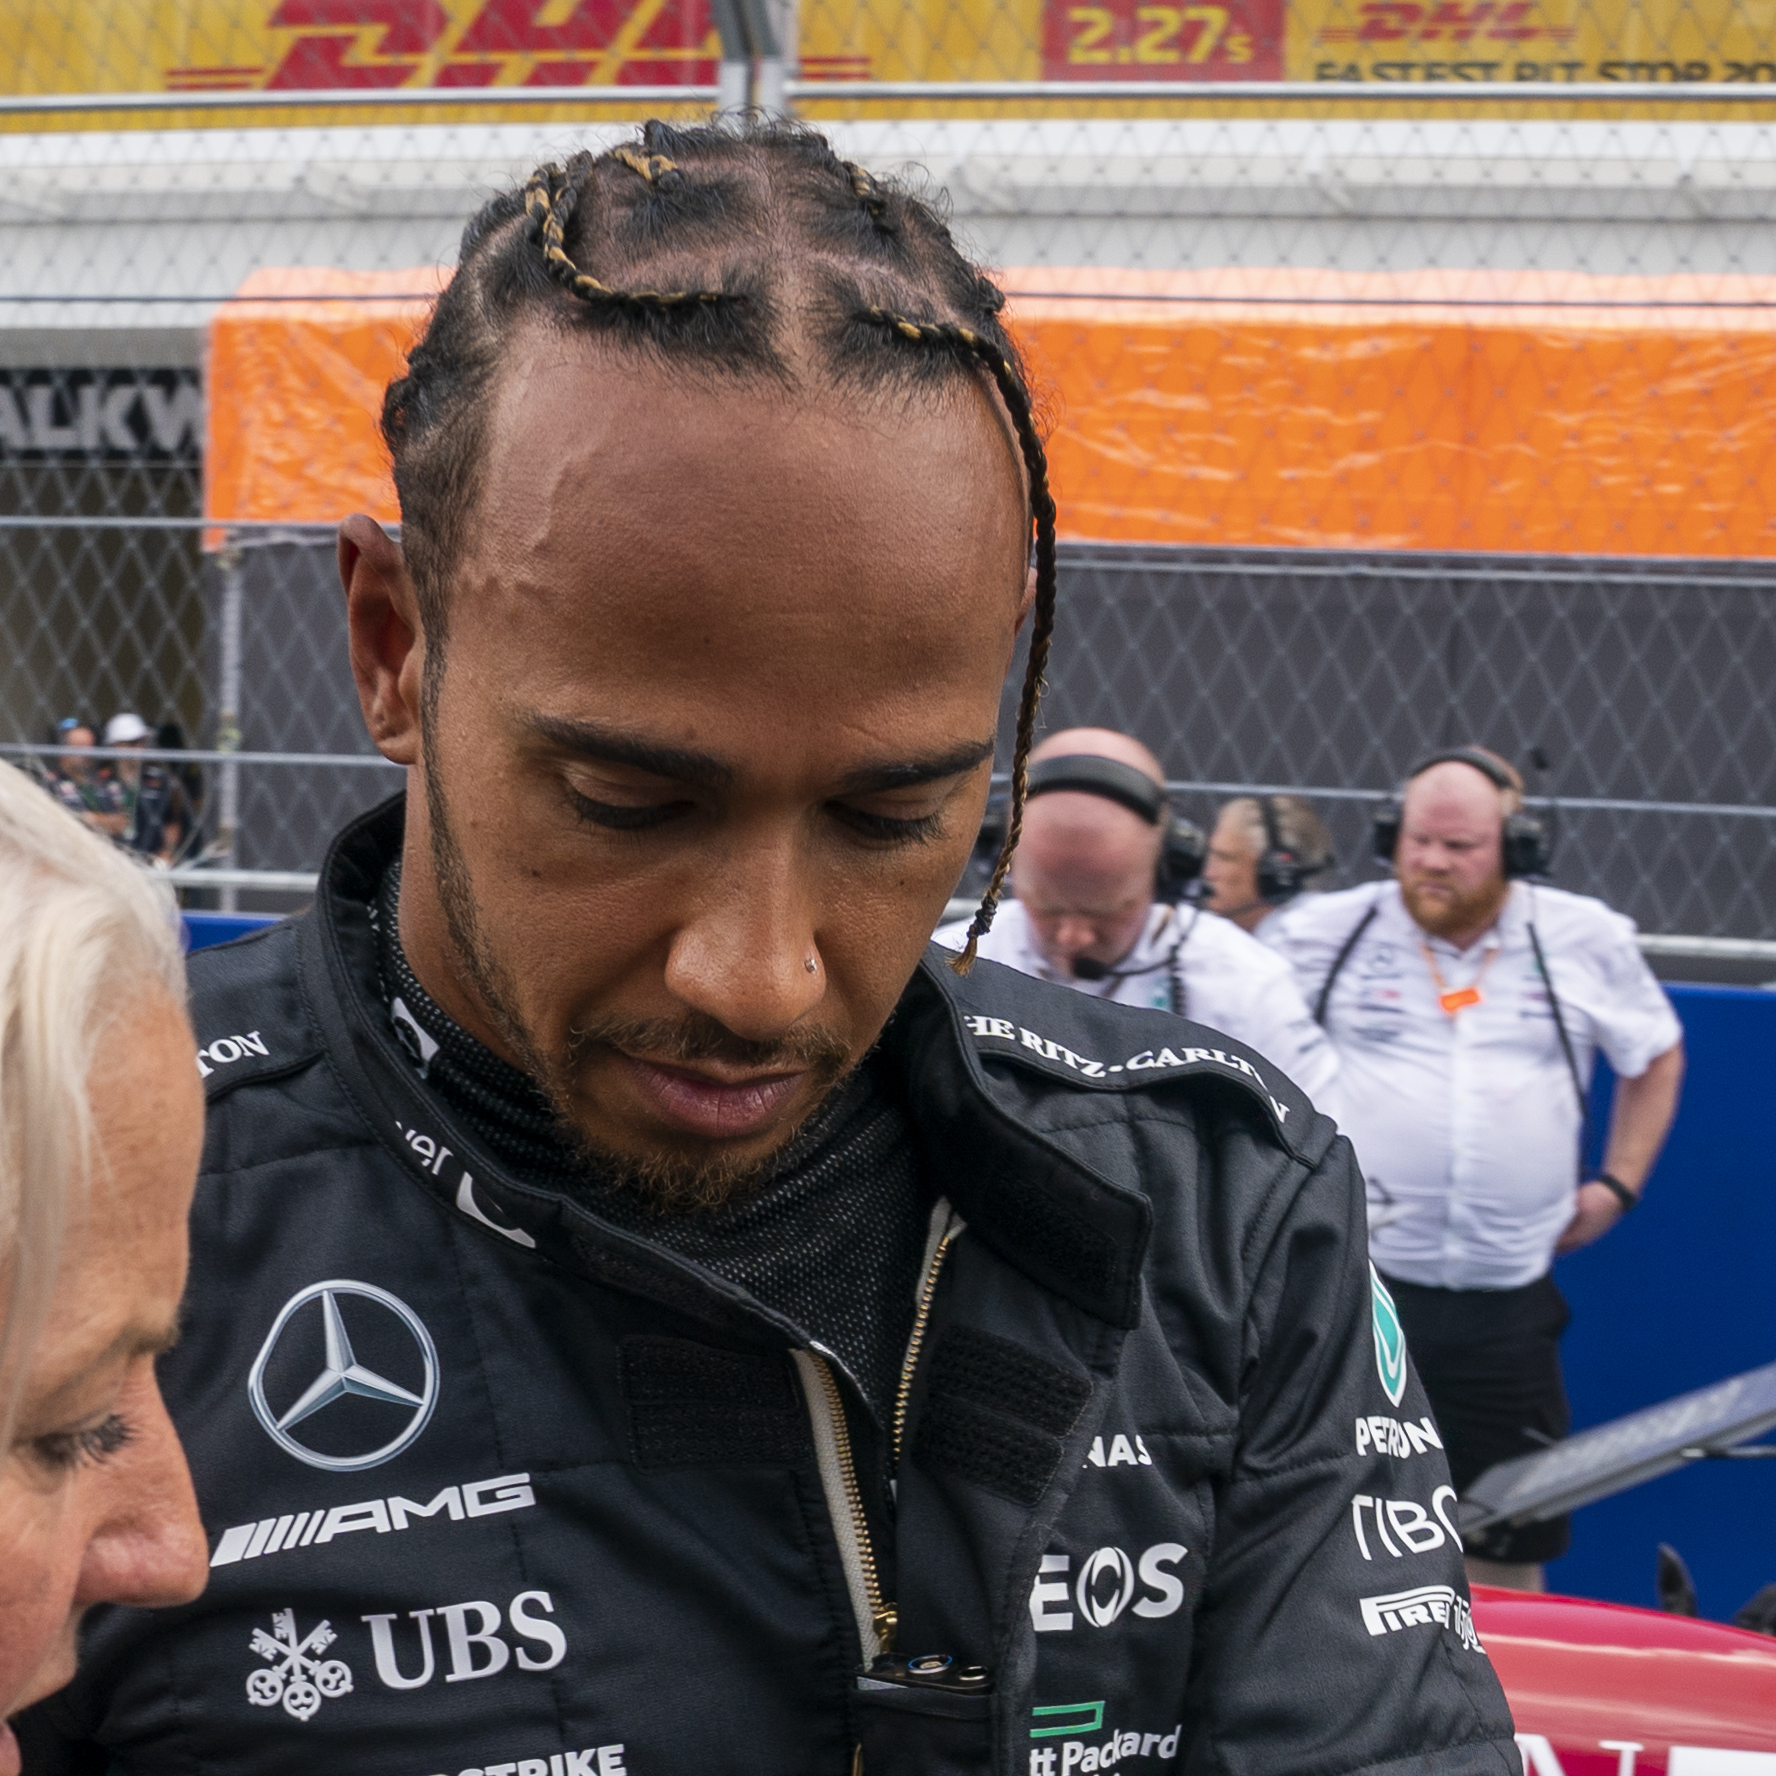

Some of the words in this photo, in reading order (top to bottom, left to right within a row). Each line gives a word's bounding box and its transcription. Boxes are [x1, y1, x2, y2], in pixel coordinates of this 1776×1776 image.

[1067, 6, 1254, 66] 2.27s
[313, 1472, 537, 1545] AMG
[360, 1590, 569, 1690] UBS
